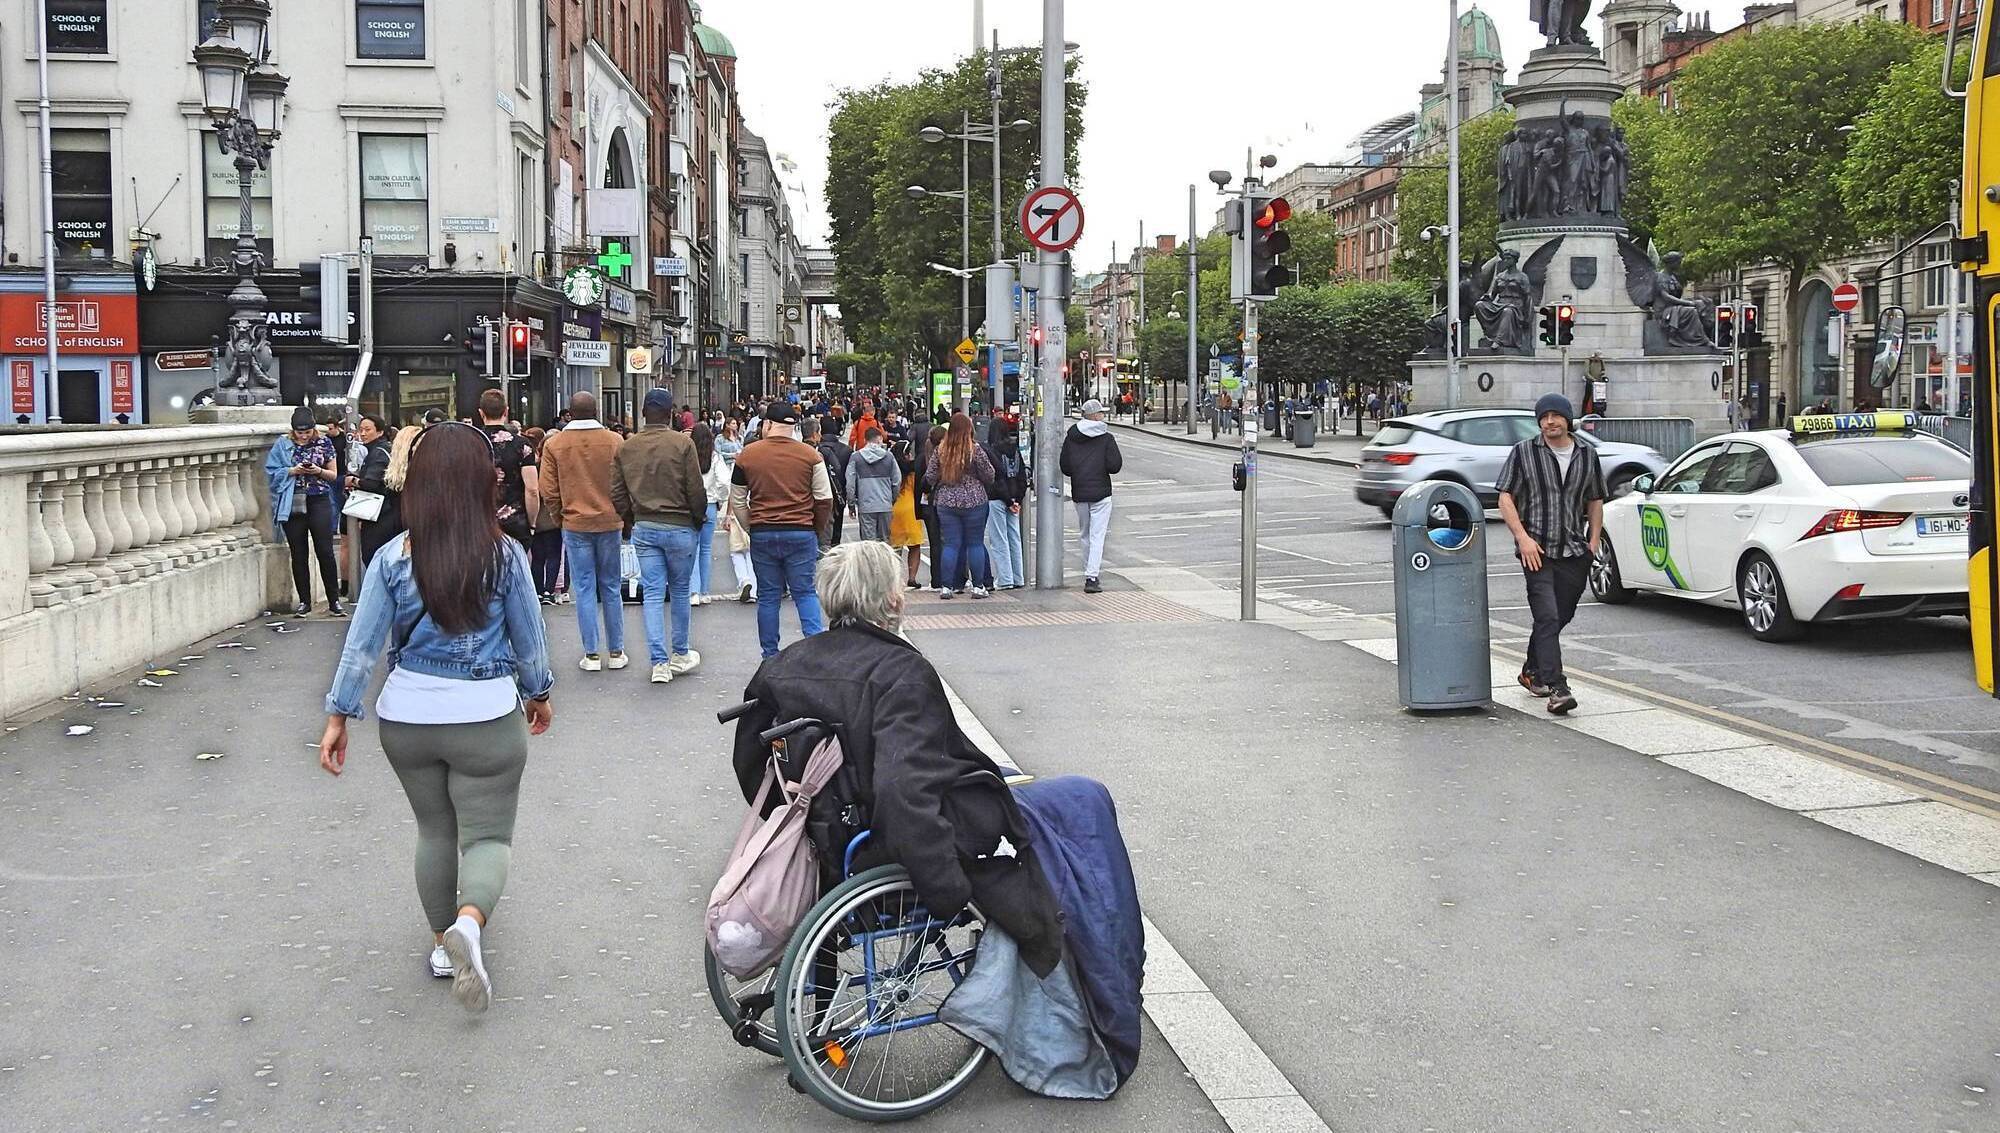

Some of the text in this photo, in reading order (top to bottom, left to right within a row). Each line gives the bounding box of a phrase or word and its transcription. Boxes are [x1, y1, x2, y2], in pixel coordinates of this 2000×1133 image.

[51, 15, 102, 23] SCHOOL OF
[58, 24, 95, 32] ENGLISH
[367, 21, 416, 30] SCHOOL OF
[374, 30, 410, 39] ENGLISH
[57, 221, 107, 230] SCHOOL OF
[373, 224, 406, 232] SCHOOL
[64, 231, 101, 239] ENGLISH
[379, 233, 416, 241] ENGLISH
[15, 337, 124, 347] SCHOL of ENGLISH
[568, 341, 608, 351] JEWELLERY
[572, 351, 601, 359] REPAIRS
[1801, 417, 1834, 431] 29866
[1835, 414, 1875, 429] TAXI
[1644, 524, 1665, 549] TAXI
